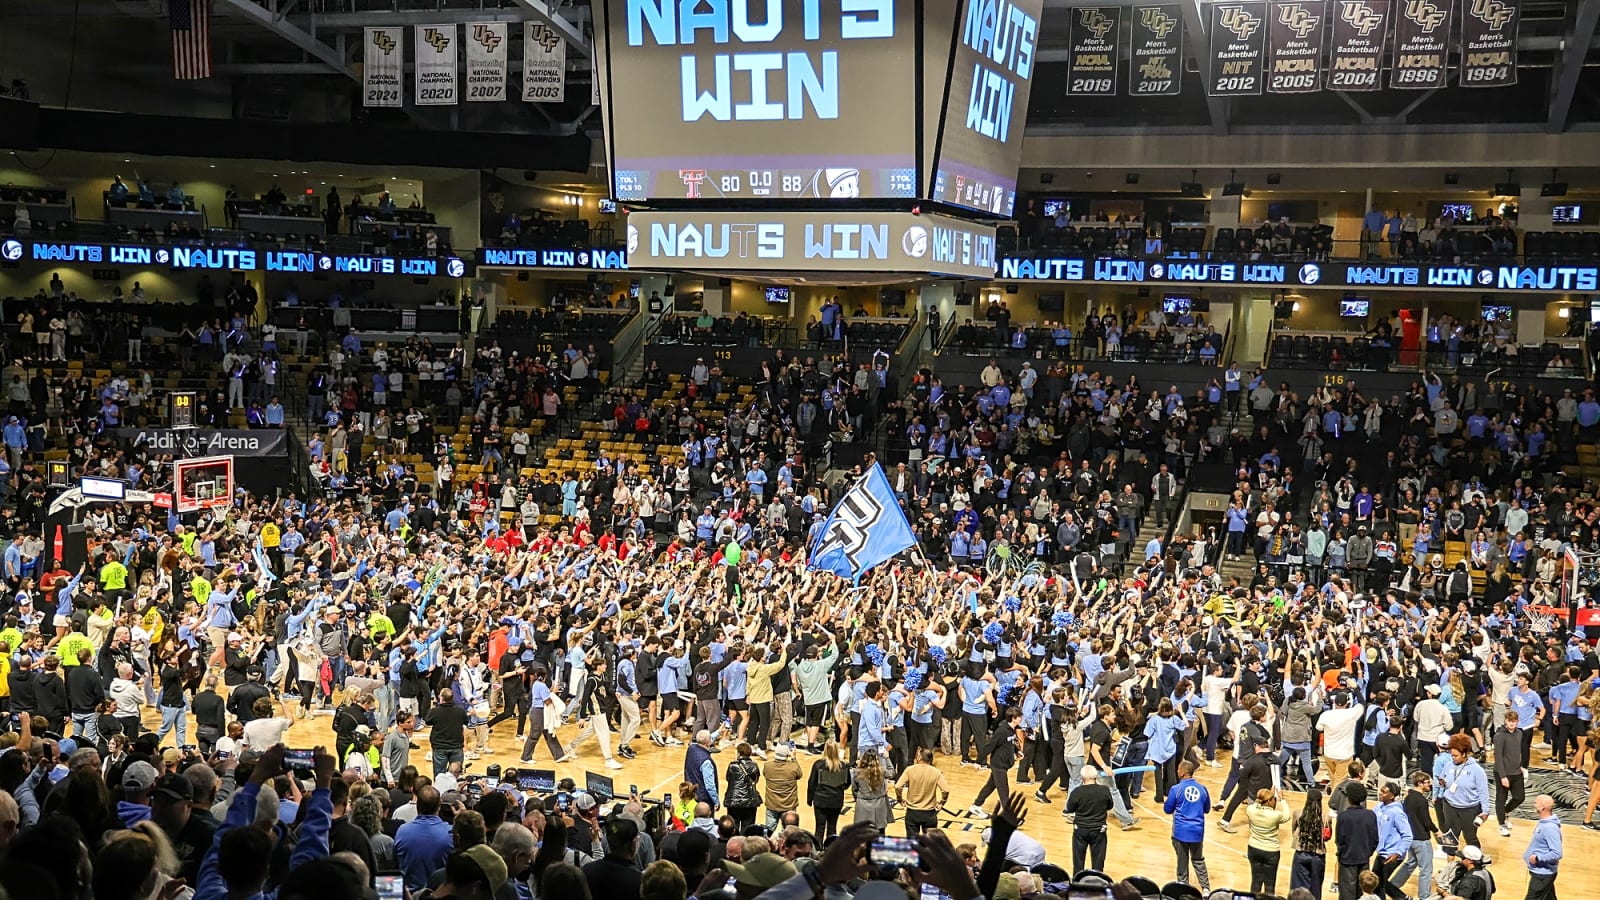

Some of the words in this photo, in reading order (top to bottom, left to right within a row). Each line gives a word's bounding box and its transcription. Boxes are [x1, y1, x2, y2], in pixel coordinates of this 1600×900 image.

[1219, 4, 1261, 40] UCF
[1278, 4, 1320, 38] UCF
[1341, 1, 1383, 36] UCF
[1405, 0, 1447, 32] UCF
[1471, 0, 1515, 30] UCF
[1078, 8, 1114, 38] UCF
[1140, 8, 1177, 38] UCF
[373, 31, 396, 55] UCF
[424, 28, 450, 53] UCF
[473, 25, 501, 52] UCF
[532, 25, 560, 53] UCF
[964, 0, 1036, 80] NAUTS
[1468, 40, 1512, 48] Basketball
[1136, 48, 1176, 56] Basketball
[1276, 47, 1317, 56] Basketball
[1401, 42, 1443, 50] Basketball
[1076, 55, 1108, 65] NCAA
[1218, 50, 1258, 58] Basketball
[1466, 52, 1510, 66] NCAA
[1222, 62, 1252, 74] NIT
[1274, 60, 1314, 72] NCAA
[1334, 58, 1376, 70] NCAA
[1398, 55, 1440, 68] NCAA
[1333, 73, 1375, 85] 2004
[1399, 70, 1437, 82] 1996
[1466, 67, 1507, 81] 1994
[681, 51, 838, 121] WIN
[1072, 79, 1112, 92] 2019
[1138, 81, 1172, 92] 2017
[1216, 78, 1254, 90] 2012
[1273, 75, 1314, 88] 2005
[368, 90, 398, 100] 2024
[420, 88, 453, 99] 2020
[471, 86, 502, 96] 2007
[527, 87, 559, 98] 2003
[966, 64, 1014, 143] WIN
[721, 176, 740, 192] 80
[750, 171, 771, 186] 0.0
[783, 176, 801, 192] 88
[650, 222, 784, 258] NAUTS
[804, 224, 888, 259] WIN
[486, 250, 536, 264] NAUTS
[543, 251, 574, 266] WIN
[974, 235, 995, 268] WIN
[33, 244, 102, 262] NAUTS
[110, 248, 150, 264] WIN
[173, 248, 256, 270] NAUTS
[266, 252, 314, 272] WIN
[336, 256, 394, 274] NAUTS
[402, 258, 436, 274] WIN
[1002, 258, 1084, 280] NAUTS
[1094, 260, 1144, 282] WIN
[1168, 264, 1234, 281] NAUTS
[1243, 266, 1284, 282] WIN
[1347, 267, 1418, 284] NAUTS
[1428, 268, 1472, 286] WIN
[1498, 267, 1598, 290] NAUTS
[538, 344, 552, 352] 112
[716, 352, 731, 360] 113
[1324, 376, 1344, 384] 116
[208, 432, 258, 449] Arena
